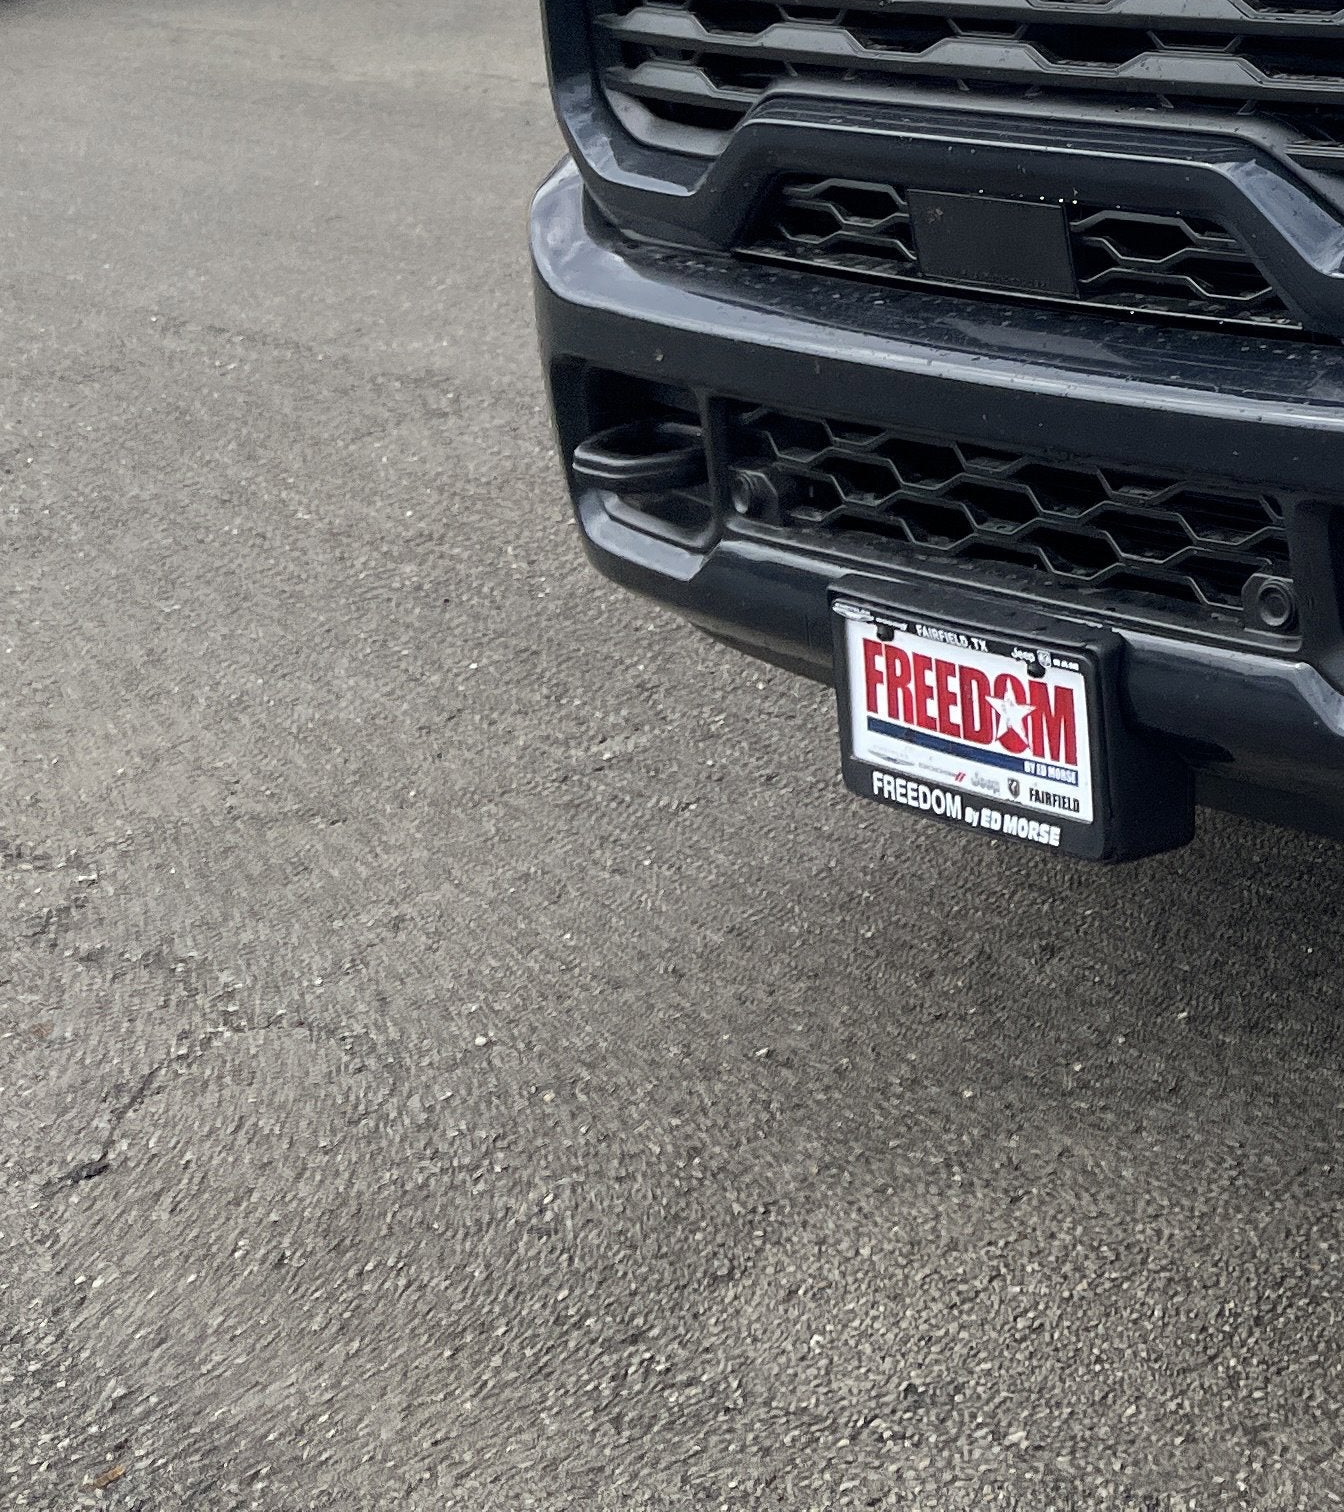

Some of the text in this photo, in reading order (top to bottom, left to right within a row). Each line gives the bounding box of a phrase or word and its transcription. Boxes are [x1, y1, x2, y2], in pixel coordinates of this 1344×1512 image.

[971, 638, 989, 653] TX
[862, 638, 1078, 767] FREEDOM
[872, 770, 962, 820] FREEDOM
[980, 807, 1001, 831] ED
[1002, 814, 1061, 847] MORSE
[1028, 788, 1080, 813] FAIRFIELD
